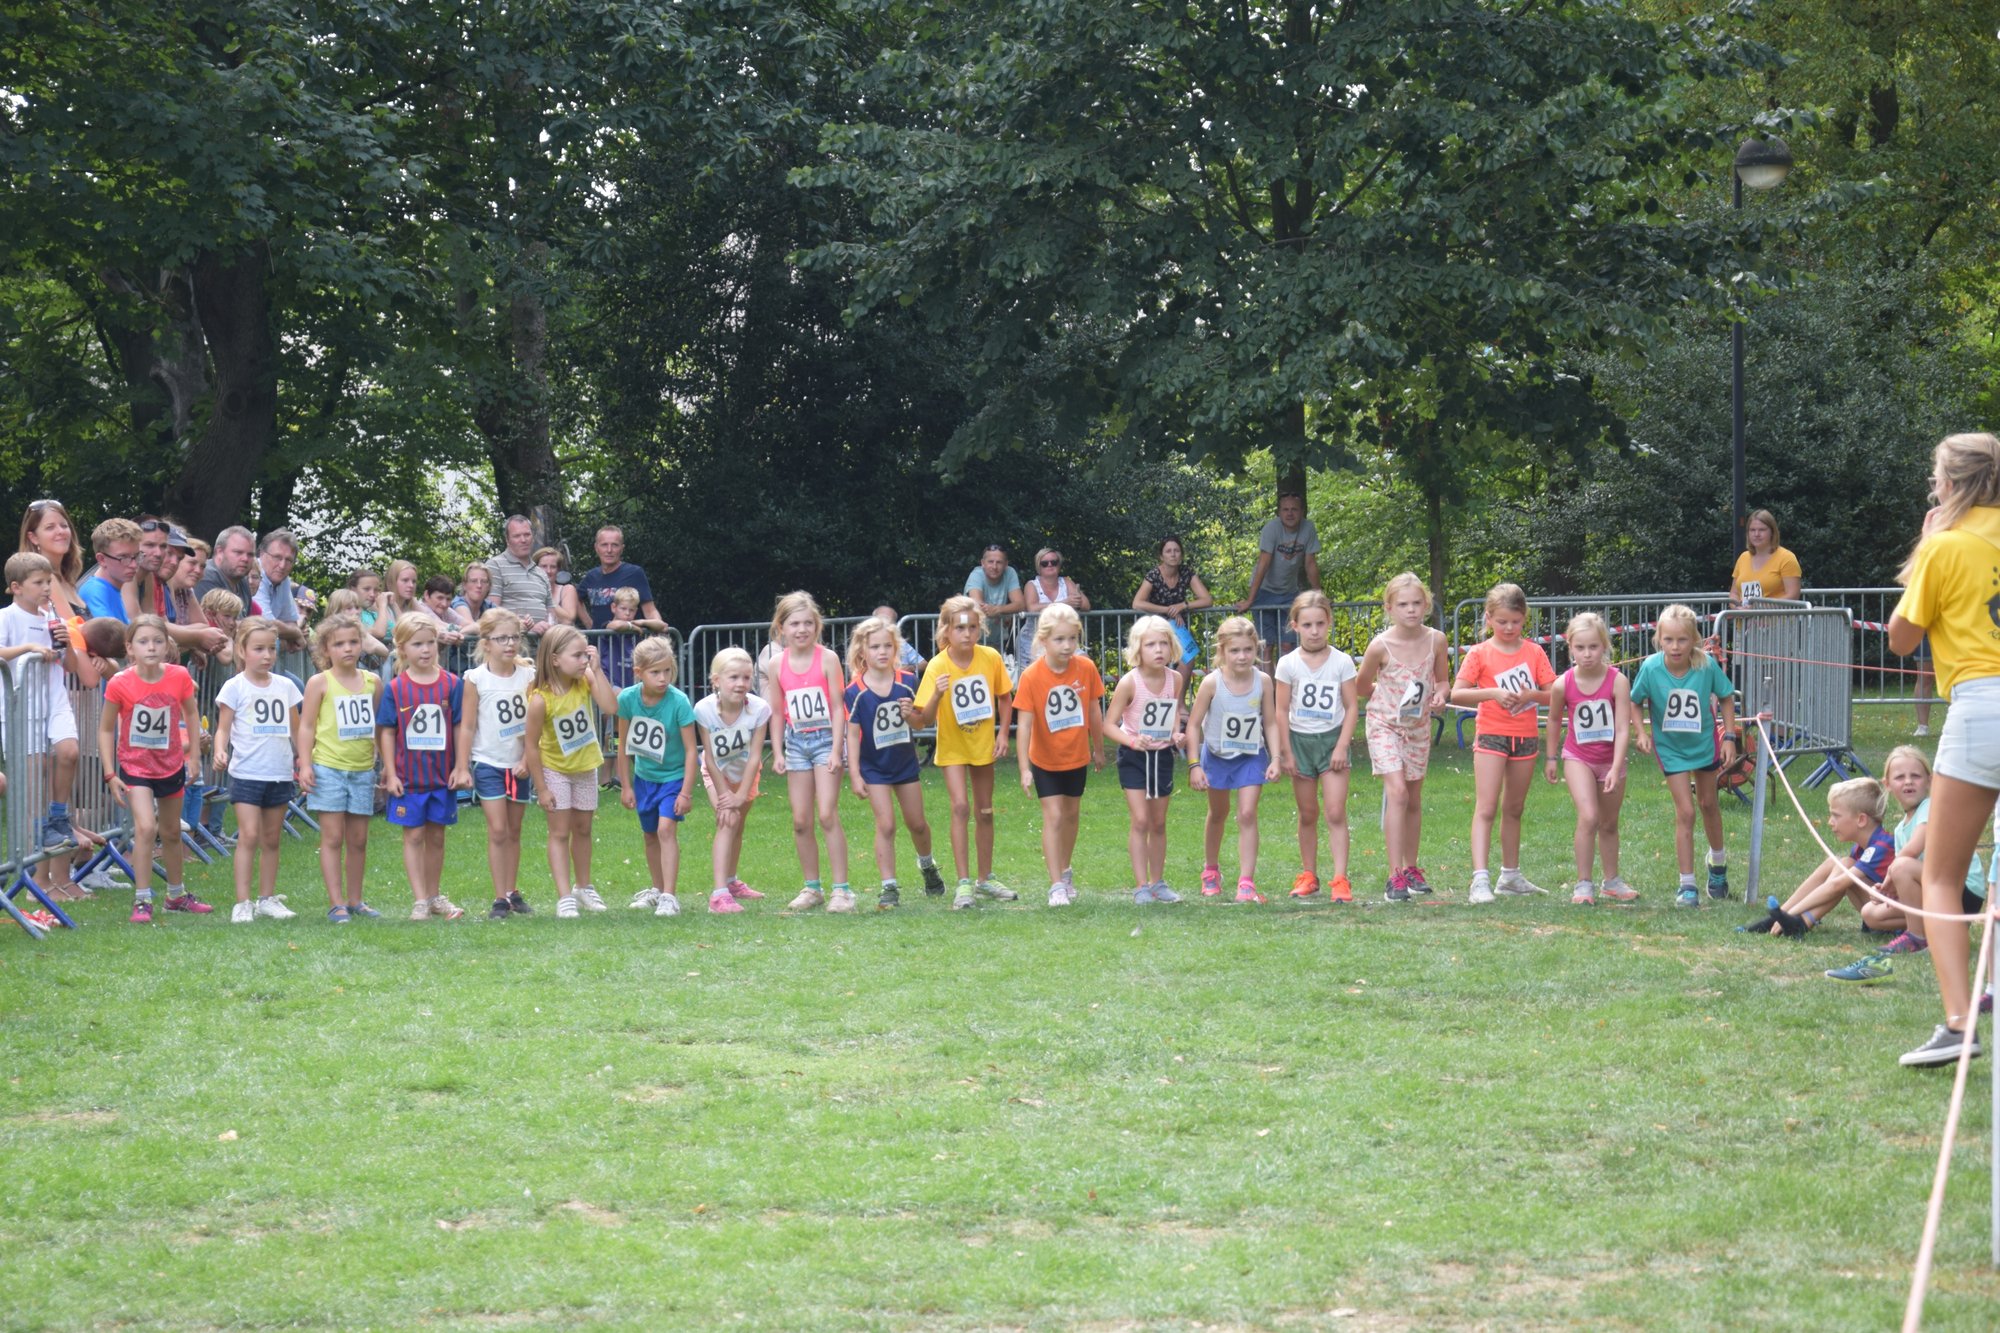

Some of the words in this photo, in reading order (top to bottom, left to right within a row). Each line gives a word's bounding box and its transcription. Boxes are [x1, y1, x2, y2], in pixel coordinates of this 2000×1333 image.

[1743, 583, 1761, 600] 443
[791, 691, 825, 720] 104
[954, 679, 986, 708] 86
[1047, 688, 1078, 716] 93
[1302, 683, 1334, 710] 85
[1667, 693, 1699, 719] 95
[135, 709, 168, 735] 94
[254, 698, 285, 724] 90
[338, 699, 371, 725] 105
[412, 709, 441, 735] 81
[496, 694, 526, 724] 88
[876, 704, 905, 732] 83
[1143, 701, 1173, 727] 87
[1578, 702, 1609, 729] 91
[558, 709, 589, 740] 98
[632, 720, 664, 750] 96
[1226, 716, 1257, 740] 97
[714, 729, 747, 758] 84
